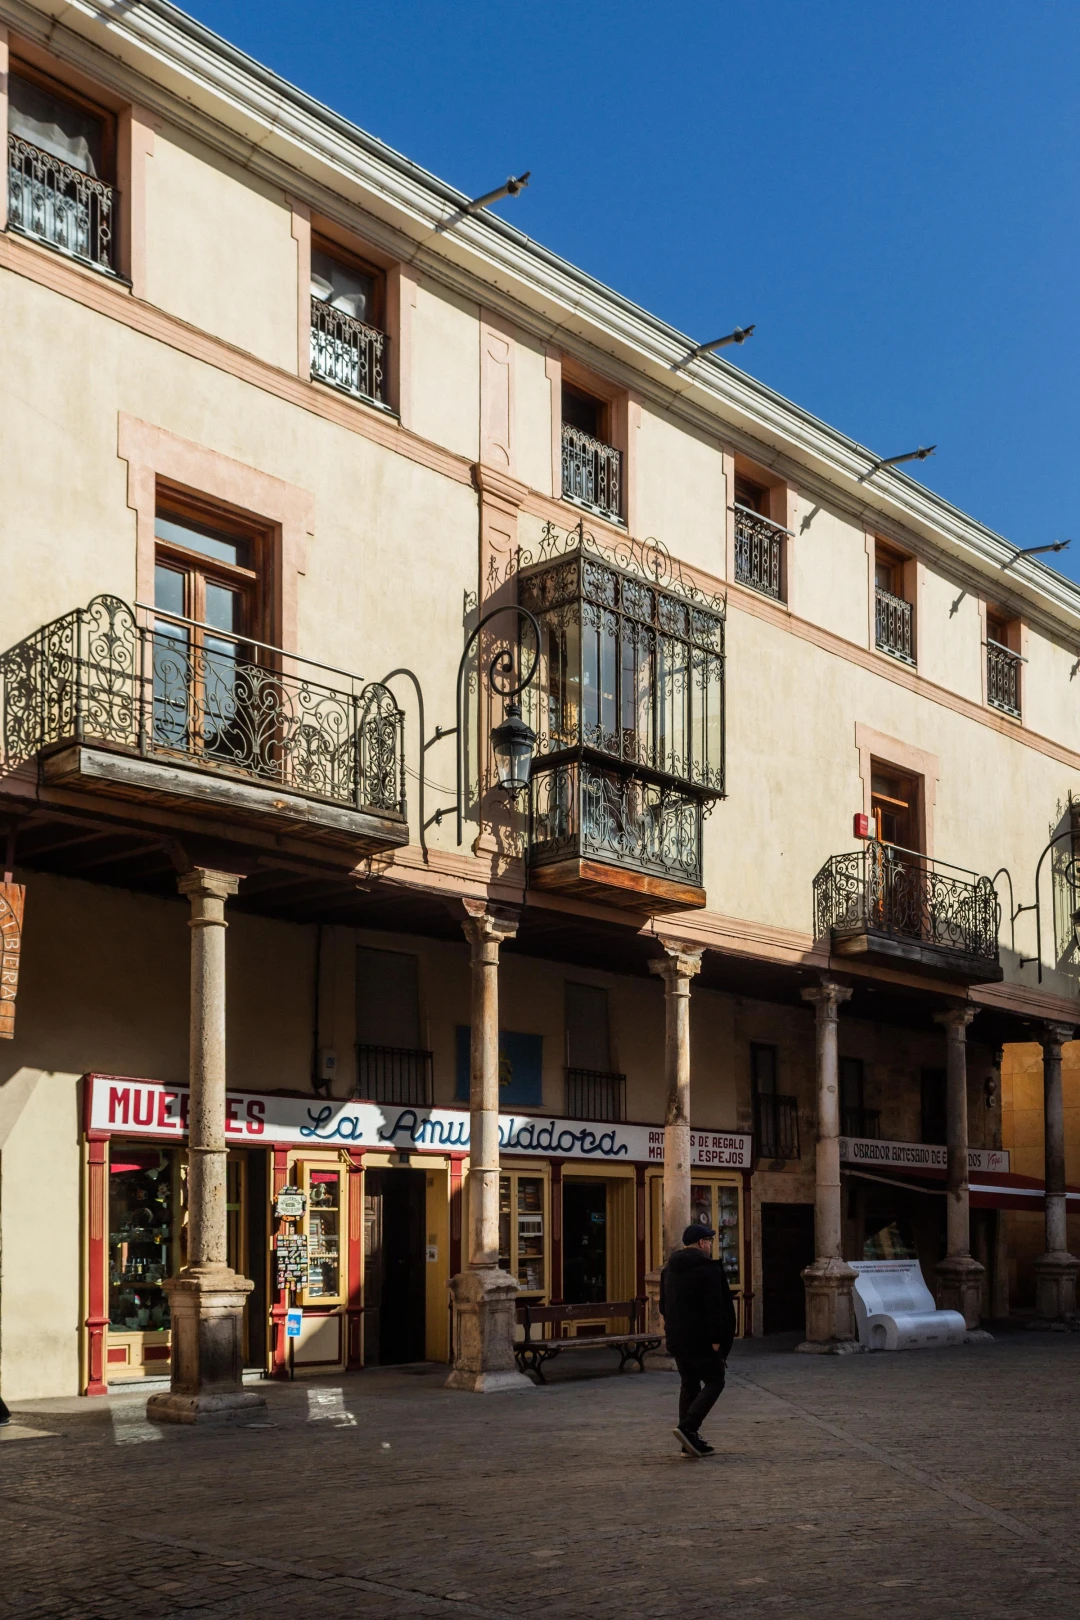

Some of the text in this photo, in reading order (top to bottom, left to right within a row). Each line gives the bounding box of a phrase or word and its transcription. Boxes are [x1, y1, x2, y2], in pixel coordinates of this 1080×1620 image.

[108, 1087, 265, 1135] MUEES
[300, 1106, 363, 1141] La
[380, 1110, 628, 1156] Amuladora
[698, 1136, 709, 1148] DE
[712, 1137, 744, 1150] REGALO
[853, 1143, 890, 1160] OBRADOR
[892, 1146, 930, 1164] ARTESANO
[931, 1150, 942, 1165] DE
[698, 1150, 744, 1164] ESPEJOS
